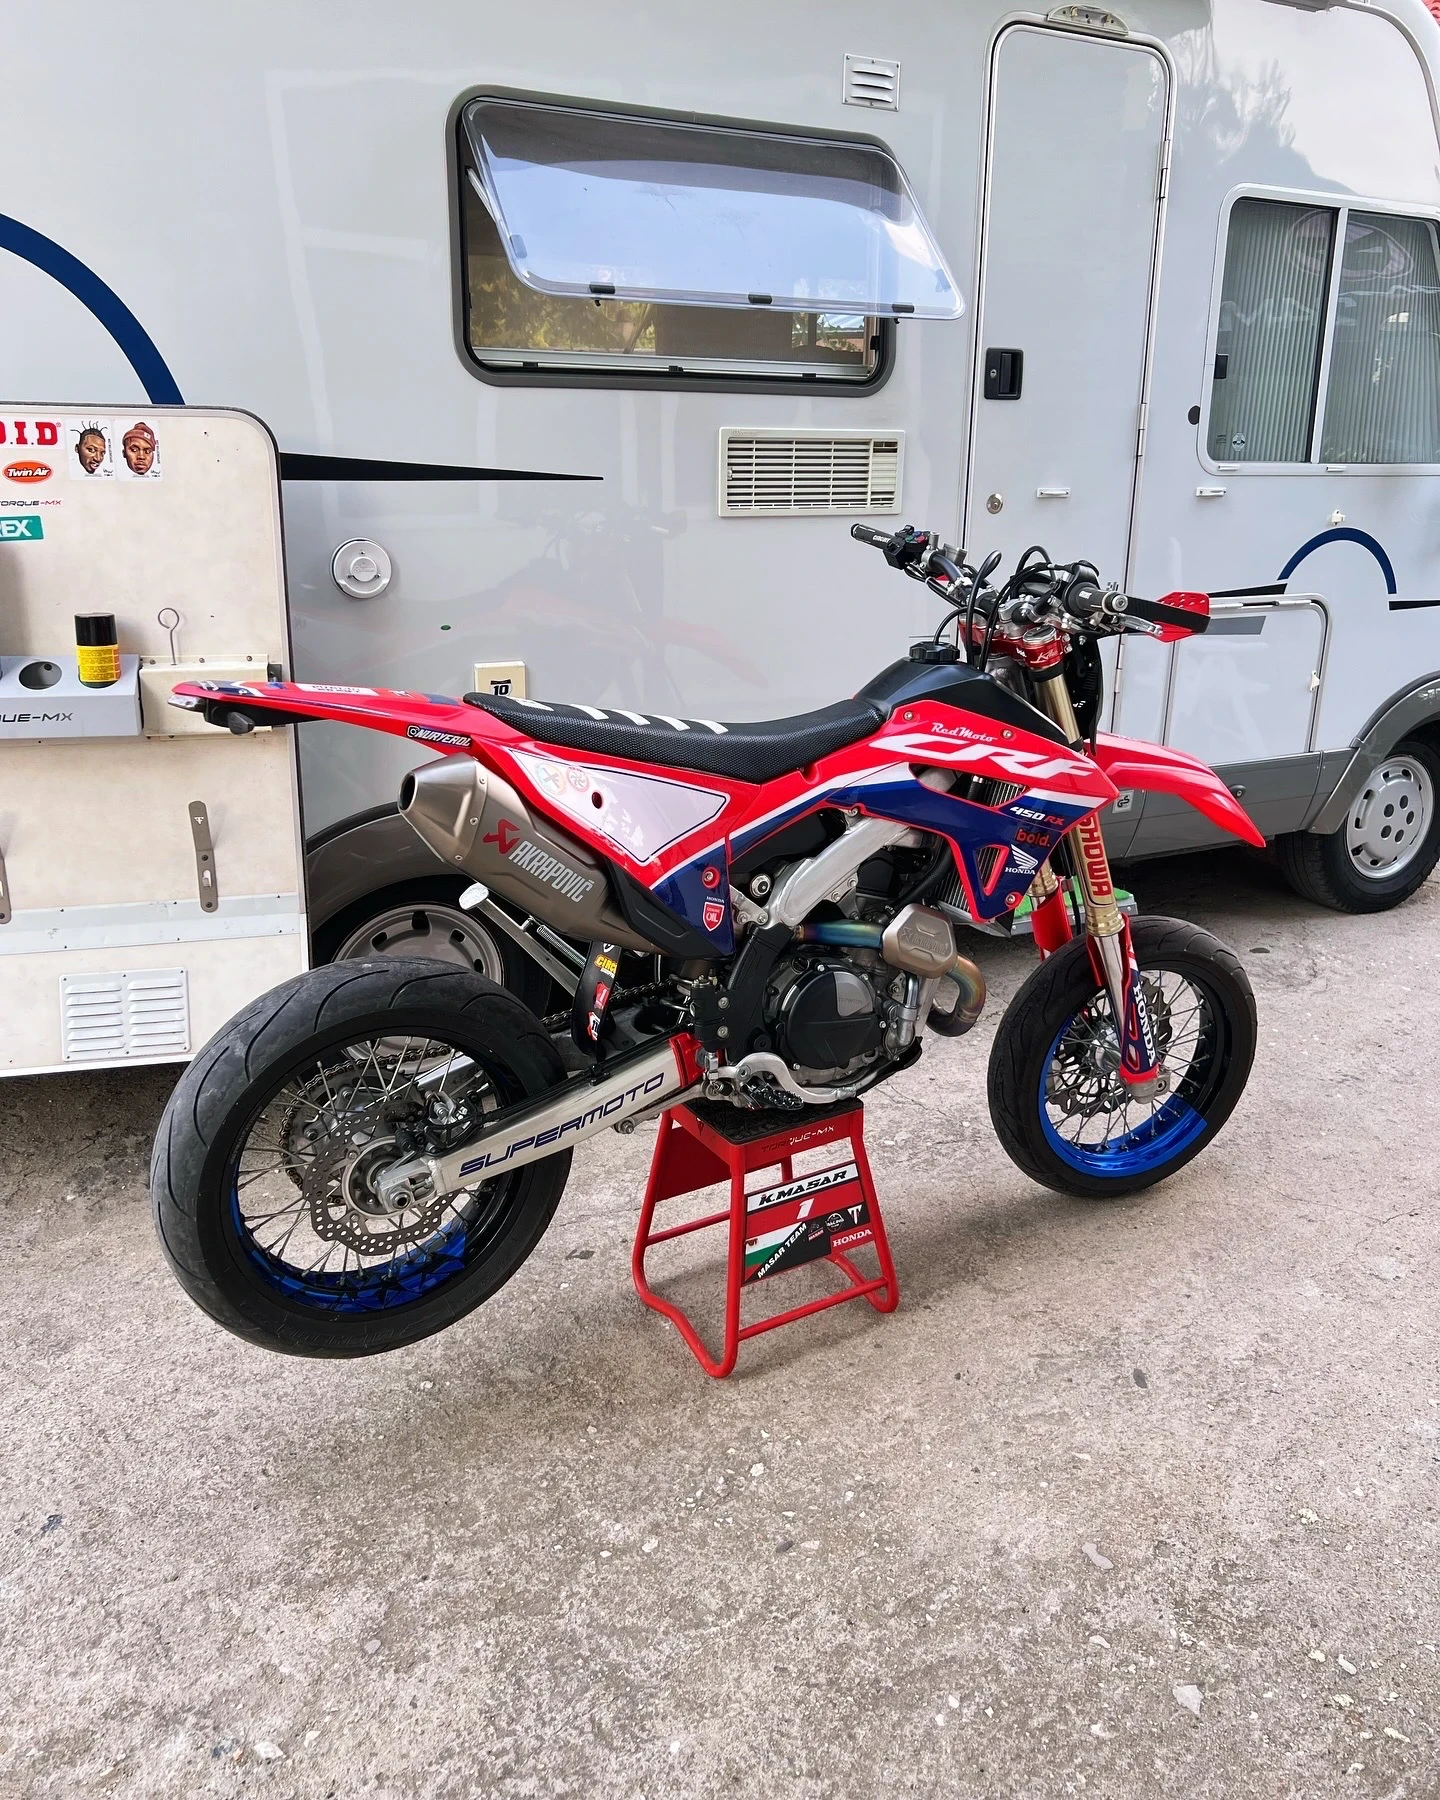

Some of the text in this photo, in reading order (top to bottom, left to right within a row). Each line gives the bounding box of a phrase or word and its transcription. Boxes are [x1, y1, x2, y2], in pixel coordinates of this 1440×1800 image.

[0, 422, 58, 445] .I.D
[7, 467, 50, 477] Twin Air
[0, 519, 32, 537] EX
[494, 685, 509, 696] 10
[0, 712, 73, 722] UE-MX
[931, 722, 998, 743] RedMoto
[869, 732, 1096, 779] CRF
[1010, 806, 1065, 825] 450 RX
[1017, 828, 1051, 847] bold.
[1005, 867, 1036, 875] HONDA
[706, 895, 725, 904] HONDA
[705, 912, 719, 923] OIL
[1132, 981, 1156, 1067] HONDA
[458, 1072, 665, 1178] SUPERMOTO
[759, 1170, 847, 1206] K.MASAR
[797, 1198, 815, 1220] 1
[832, 1228, 872, 1247] HONDA
[757, 1222, 807, 1278] MASAR TEAM
